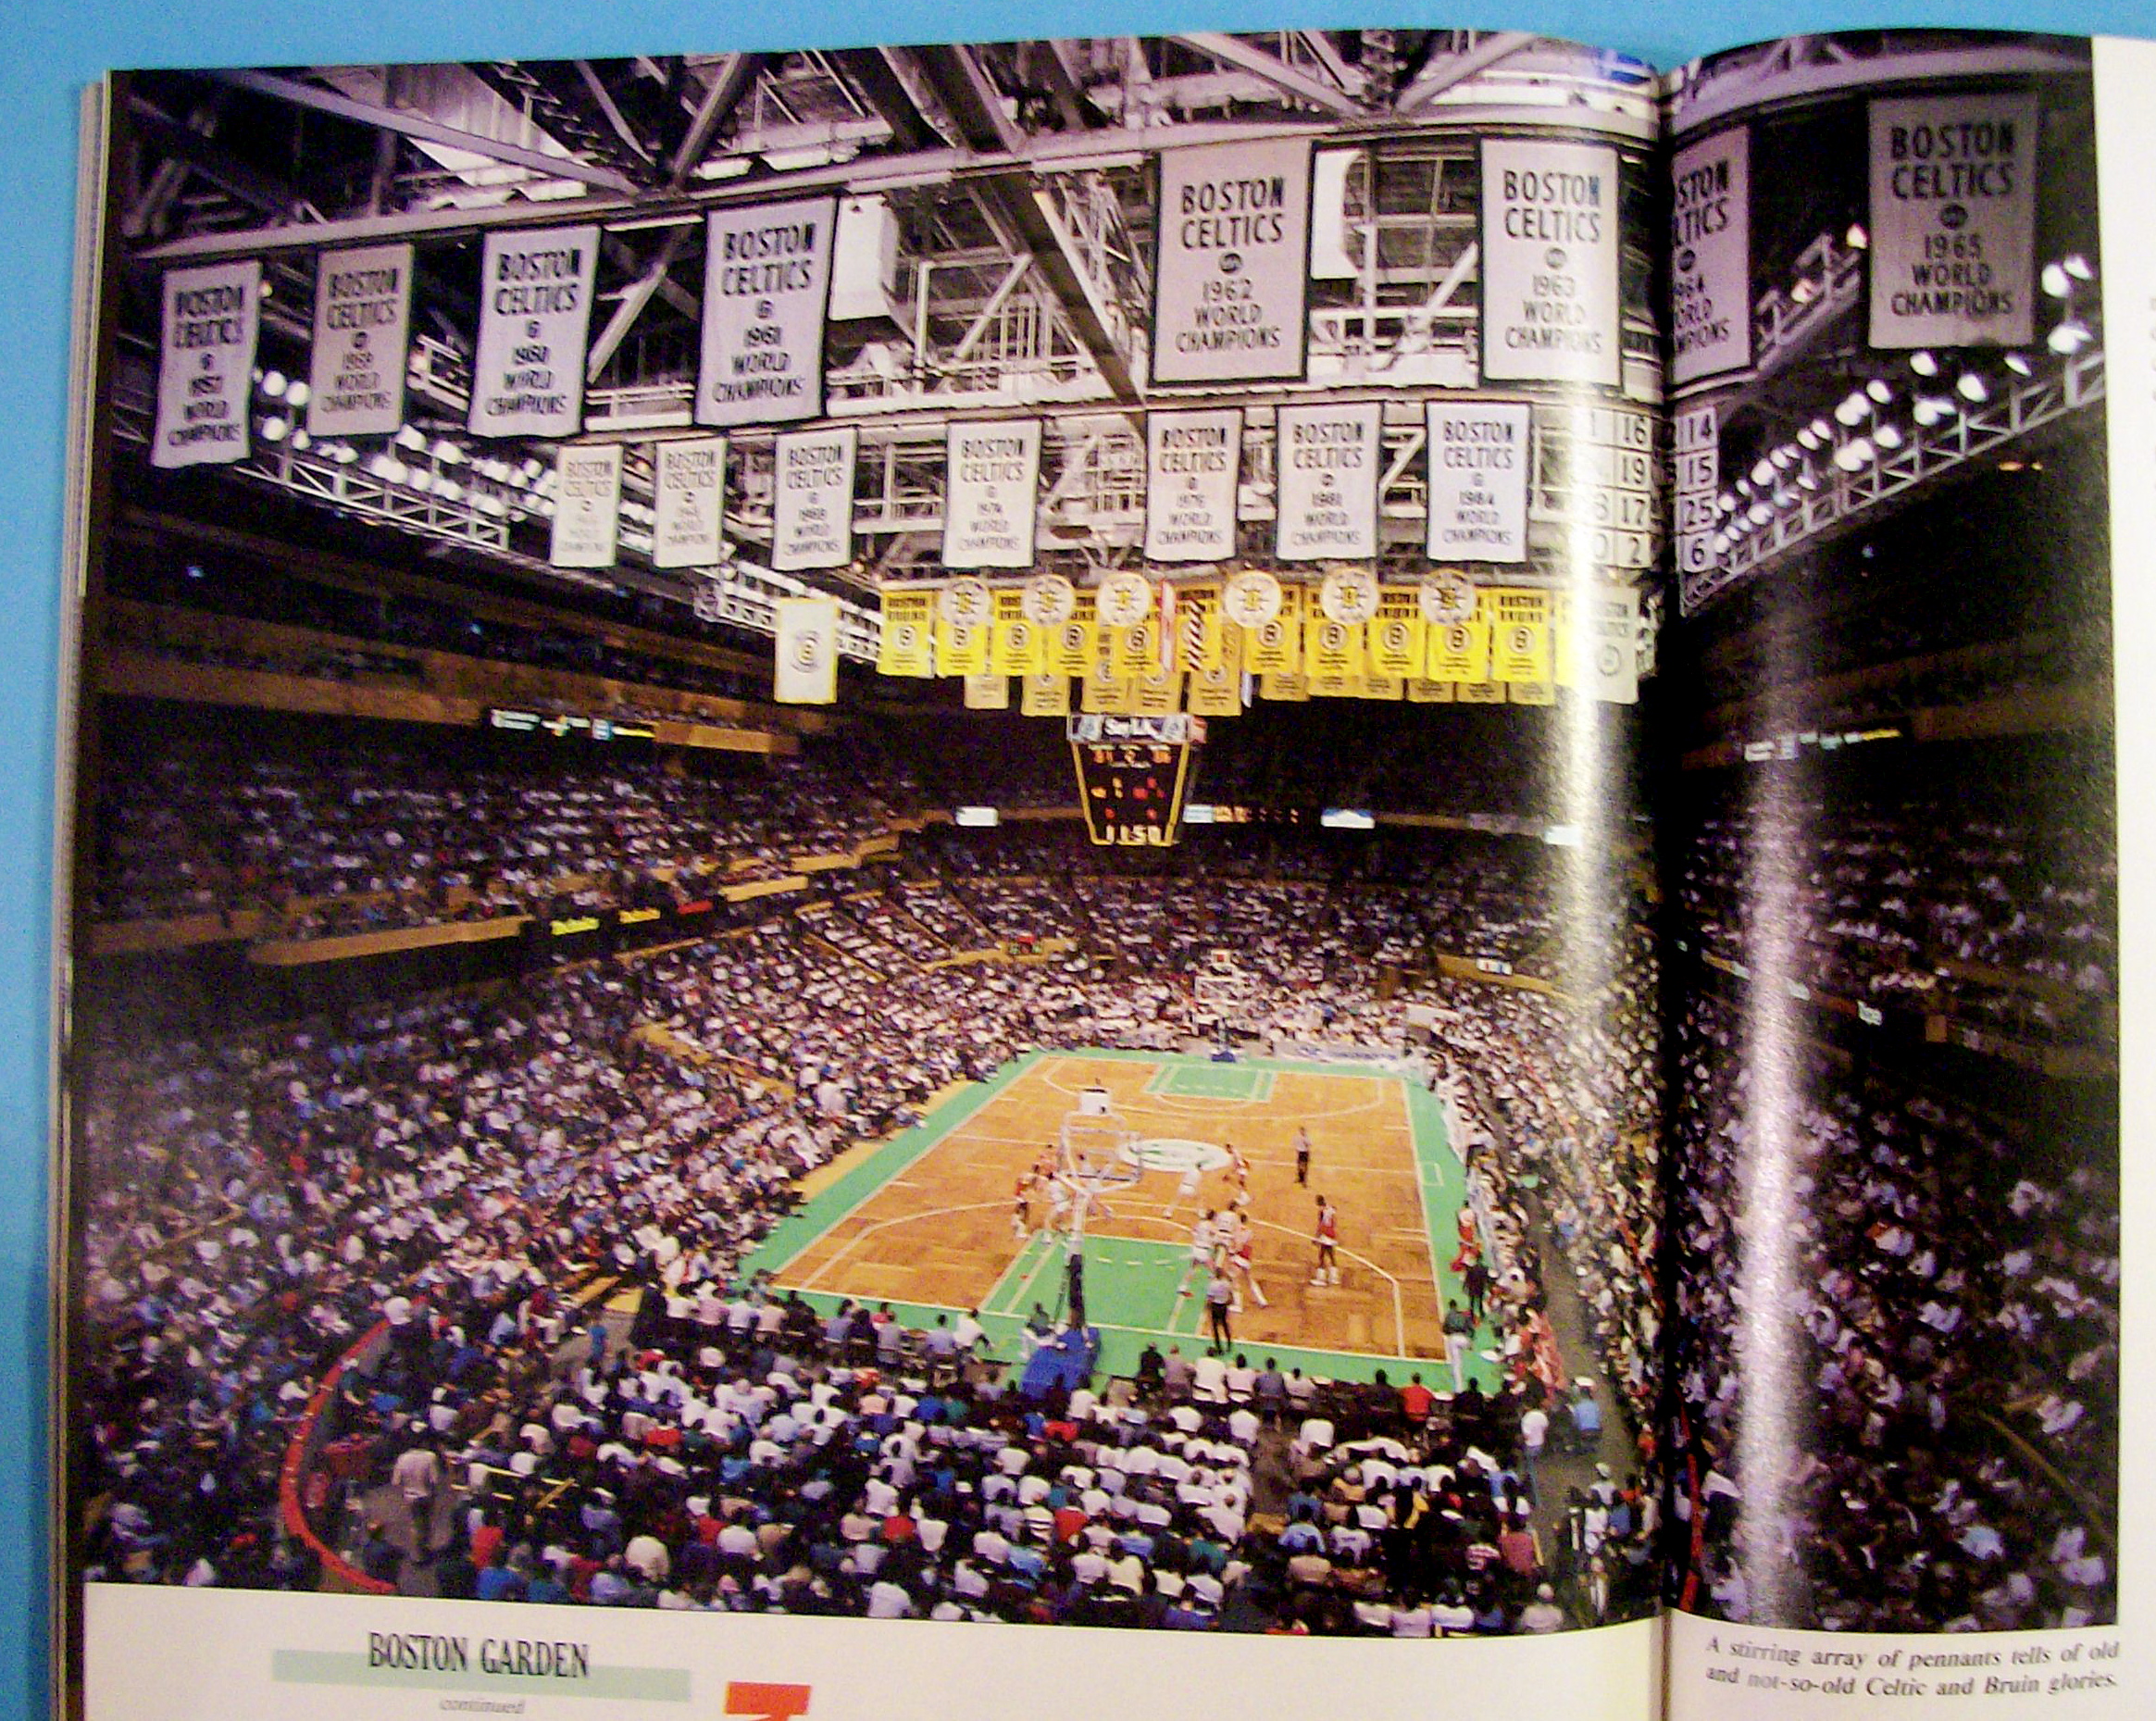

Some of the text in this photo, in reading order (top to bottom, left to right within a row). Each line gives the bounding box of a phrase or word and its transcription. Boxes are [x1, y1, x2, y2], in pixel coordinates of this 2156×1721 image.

[1890, 122, 2013, 159] BOSTON
[1181, 174, 1285, 215] BOSTON
[1503, 169, 1601, 206] BOSTON
[1892, 162, 2014, 200] CELTICS
[1181, 213, 1285, 249] CELTICS
[1504, 207, 1601, 243] CELTICS
[723, 221, 816, 259] BOSTON
[497, 248, 581, 281] BOSTON
[722, 258, 813, 296] CELTICS
[1913, 263, 1991, 287] WORLD
[328, 268, 398, 299] BOSTON
[1203, 278, 1252, 302] 1962
[495, 282, 579, 316] CELTICS
[1523, 300, 1586, 325] WORLD
[1890, 290, 2013, 318] CHAMPIONS
[327, 298, 397, 330] CELTICS
[1194, 303, 1263, 327] WORLD
[1176, 325, 1281, 352] CHAMPIONS
[731, 352, 791, 375] WORLD
[713, 376, 805, 403] CHAMPIONS
[1161, 427, 1228, 449] BOSTON
[1292, 421, 1365, 443] BOSTON
[1443, 420, 1514, 443] BOSTON
[1689, 414, 1712, 443] 14
[961, 438, 1026, 458] BOSTON
[1160, 451, 1227, 472] CELTICS
[1293, 446, 1363, 468] CELTICS
[1444, 446, 1513, 468] CELTICS
[960, 462, 1024, 482] CELTICS
[1622, 455, 1646, 484] 19
[1689, 455, 1712, 485] 15
[1623, 498, 1646, 525] 17
[1692, 538, 1704, 566] 6
[368, 1630, 589, 1677] BOSTON GARDEN
[1706, 1636, 2120, 1671] A stirring array of pennants tells of old
[1706, 1667, 1739, 1684] and
[1747, 1674, 1855, 1694] not-so-old
[1866, 1677, 1926, 1696] Celtic
[1936, 1677, 1975, 1695] and
[1984, 1675, 2039, 1695] Bruin
